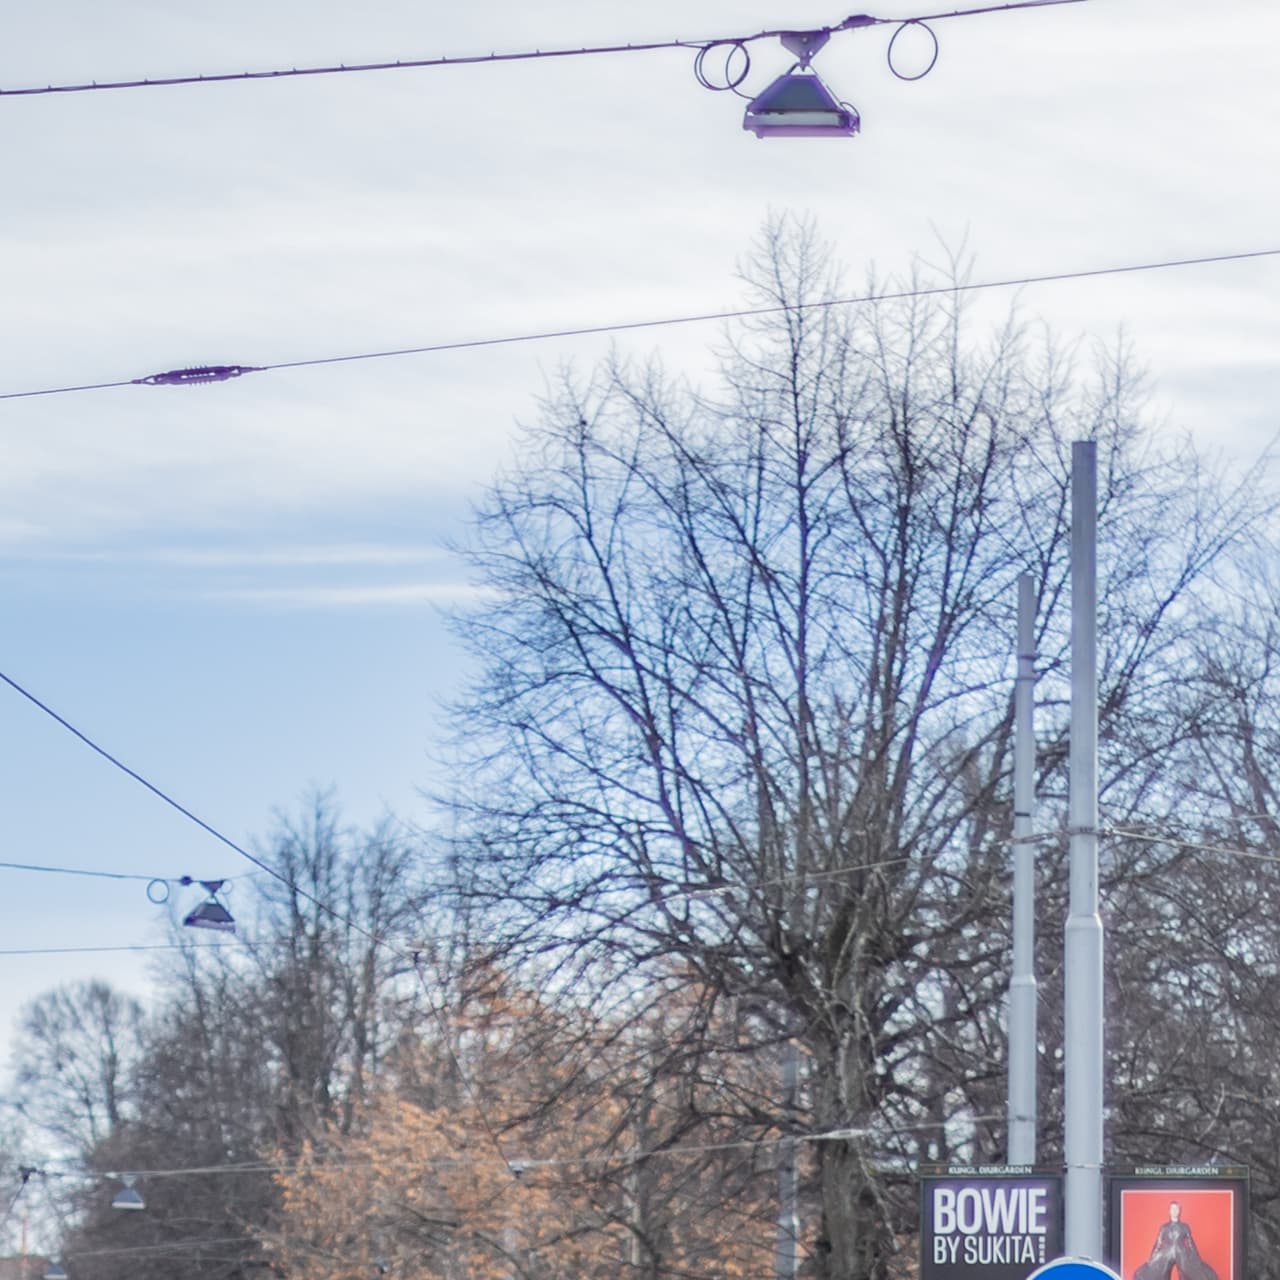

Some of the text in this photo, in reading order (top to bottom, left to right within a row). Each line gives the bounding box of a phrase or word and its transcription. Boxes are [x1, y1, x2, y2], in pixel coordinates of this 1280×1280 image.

[933, 1187, 1047, 1235] BOWIE
[933, 1235, 1036, 1264] BY SUKITA
